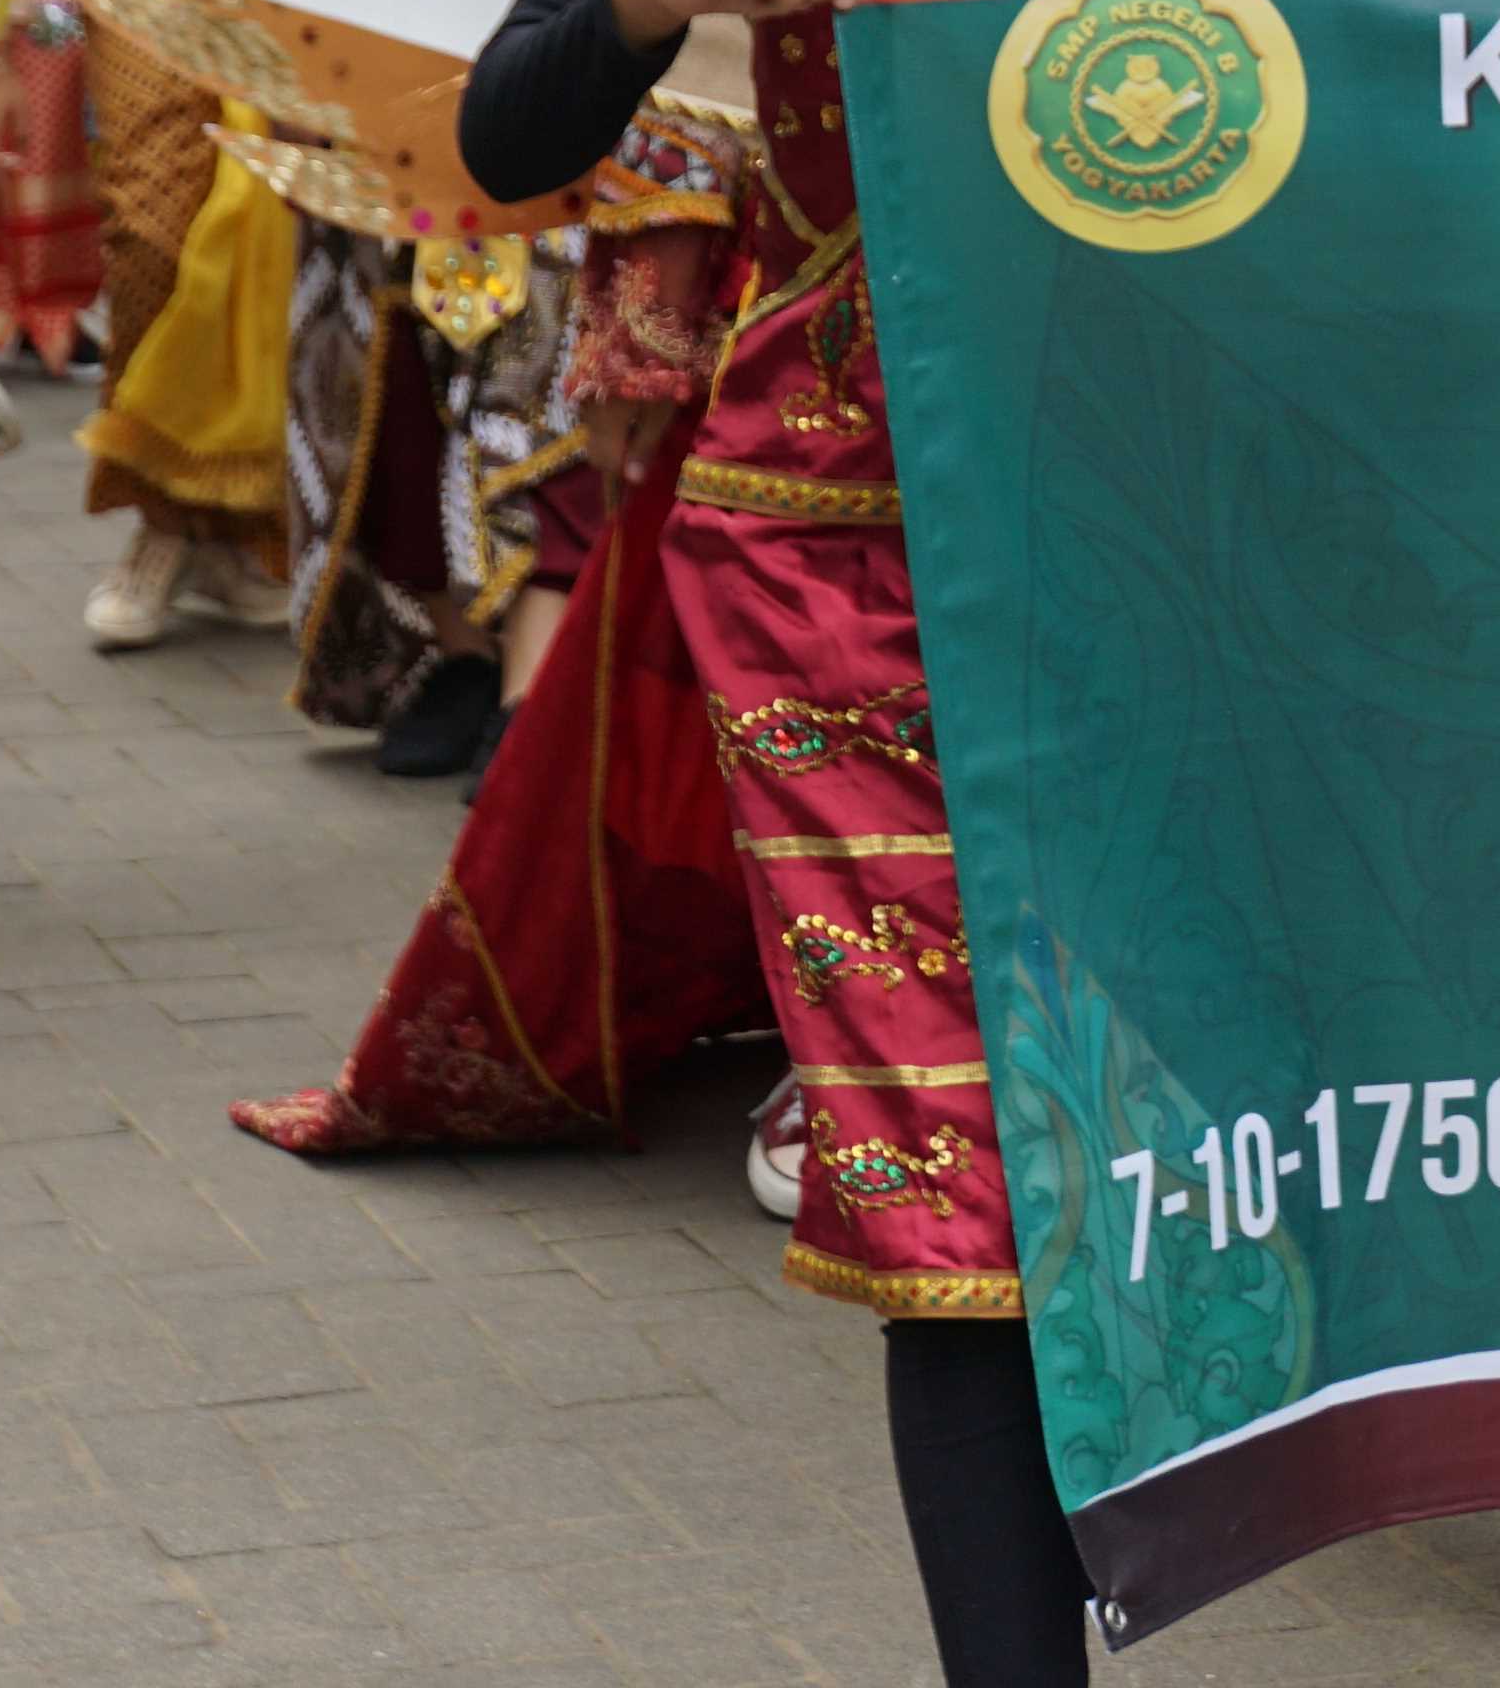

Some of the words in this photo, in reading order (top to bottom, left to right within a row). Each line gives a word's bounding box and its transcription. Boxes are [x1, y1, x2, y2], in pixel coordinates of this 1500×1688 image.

[1048, 16, 1097, 78] SMP
[1111, 1, 1222, 46] NEGERI
[1053, 130, 1242, 199] YOGYAKARTA
